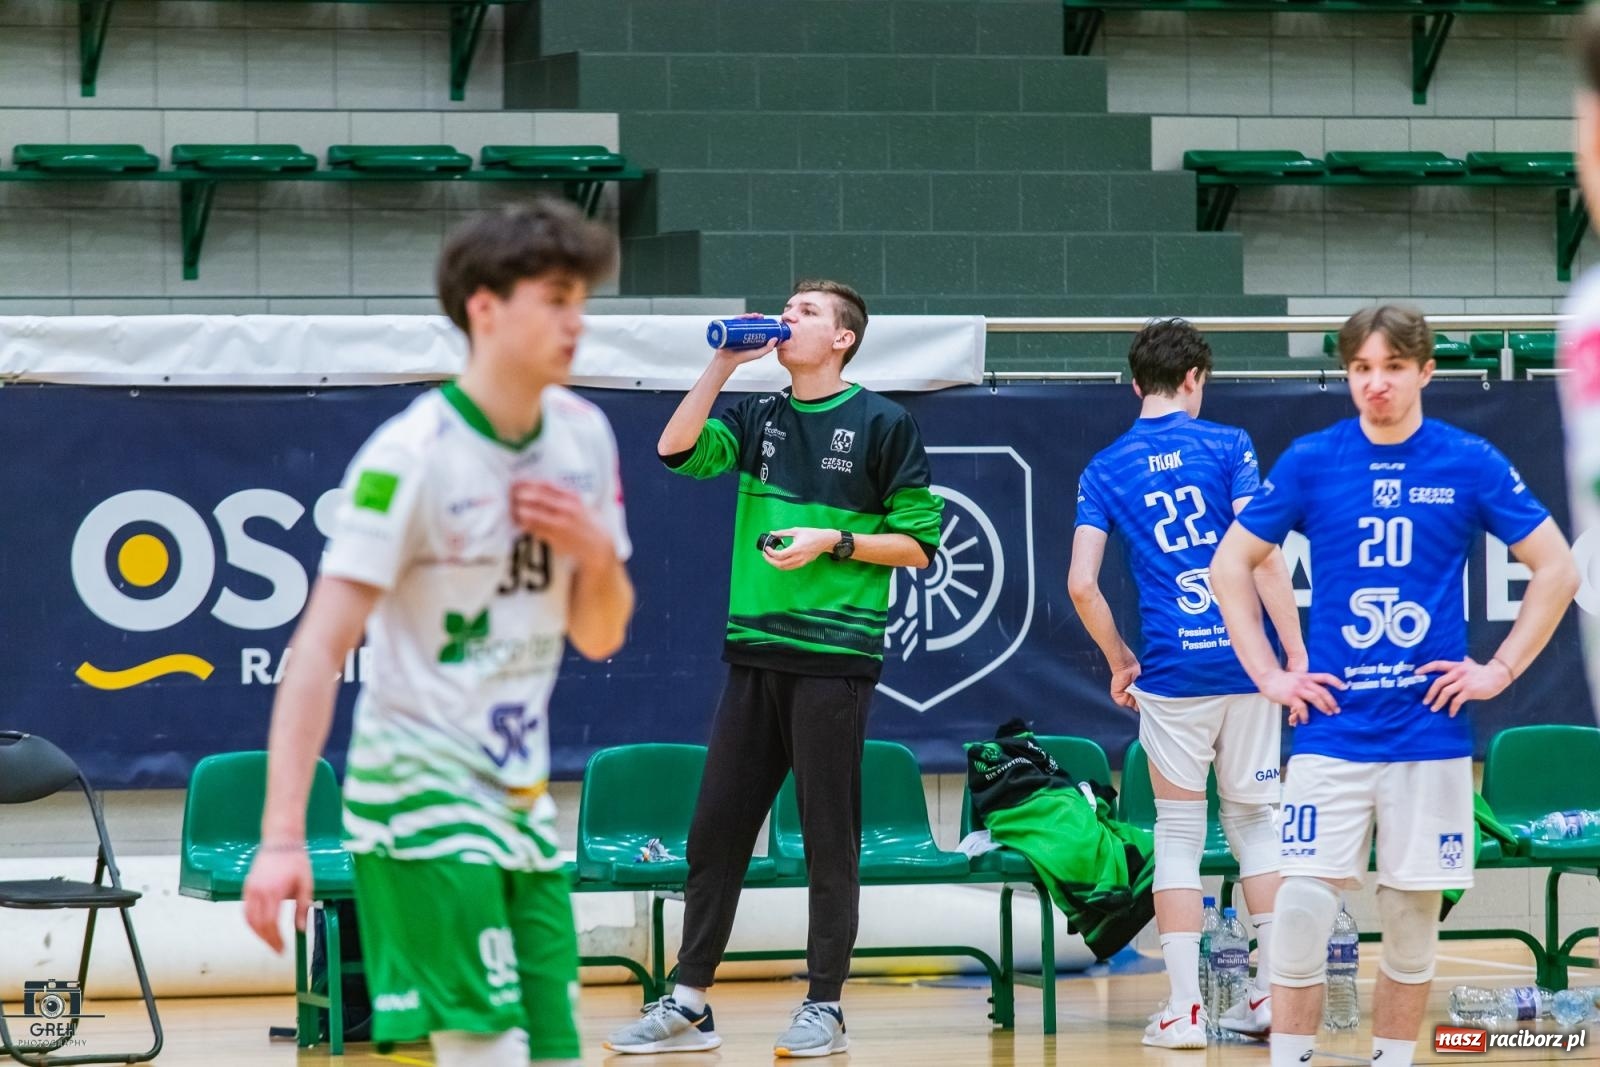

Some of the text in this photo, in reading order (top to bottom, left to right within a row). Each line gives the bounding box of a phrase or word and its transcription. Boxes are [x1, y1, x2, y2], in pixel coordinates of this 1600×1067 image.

[1144, 485, 1218, 553] 22
[1358, 516, 1413, 567] 20
[1178, 625, 1226, 637] Passion for
[1182, 638, 1231, 650] Passion for
[1281, 804, 1317, 843] 20
